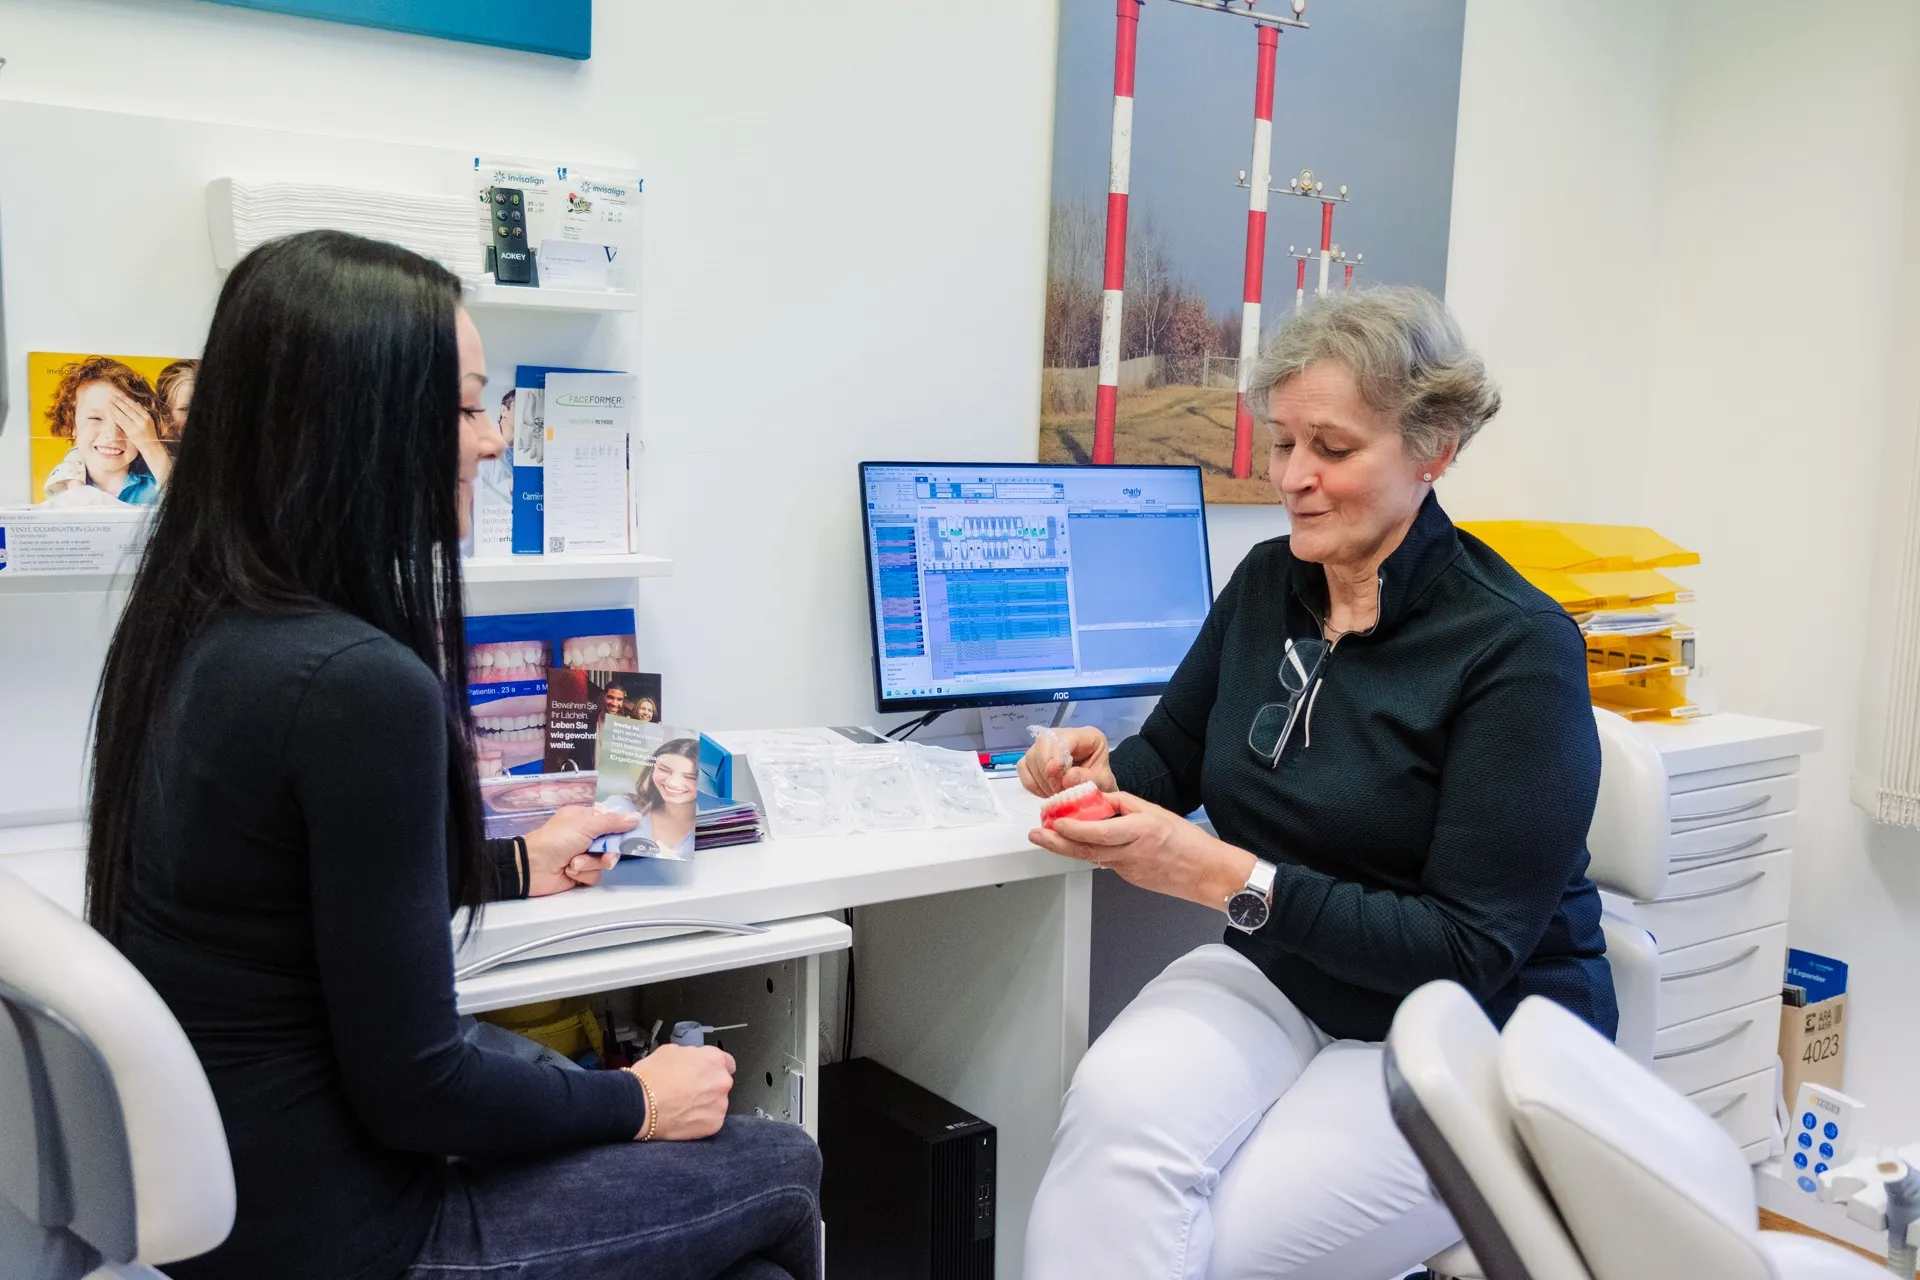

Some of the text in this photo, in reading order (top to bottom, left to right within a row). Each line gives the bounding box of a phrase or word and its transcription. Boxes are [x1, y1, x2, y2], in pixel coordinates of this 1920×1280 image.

[508, 173, 545, 185] invisalign
[593, 184, 625, 197] invisalign
[498, 194, 519, 205] A B
[501, 228, 507, 236] E
[501, 252, 526, 261] AOKEY
[46, 367, 84, 377] invisali
[569, 395, 623, 405] FACEFORMER
[1122, 487, 1142, 496] charly
[501, 686, 510, 694] 23
[1053, 691, 1070, 700] AOC
[551, 700, 598, 710] Bewahren Sie
[551, 710, 561, 719] Ihr
[551, 720, 588, 730] Leben Sie
[550, 731, 598, 740] wie gewohnt
[550, 741, 576, 749] weiter.
[1792, 968, 1826, 983] Expander
[1818, 1009, 1832, 1022] ARA
[1802, 1033, 1840, 1064] 4023
